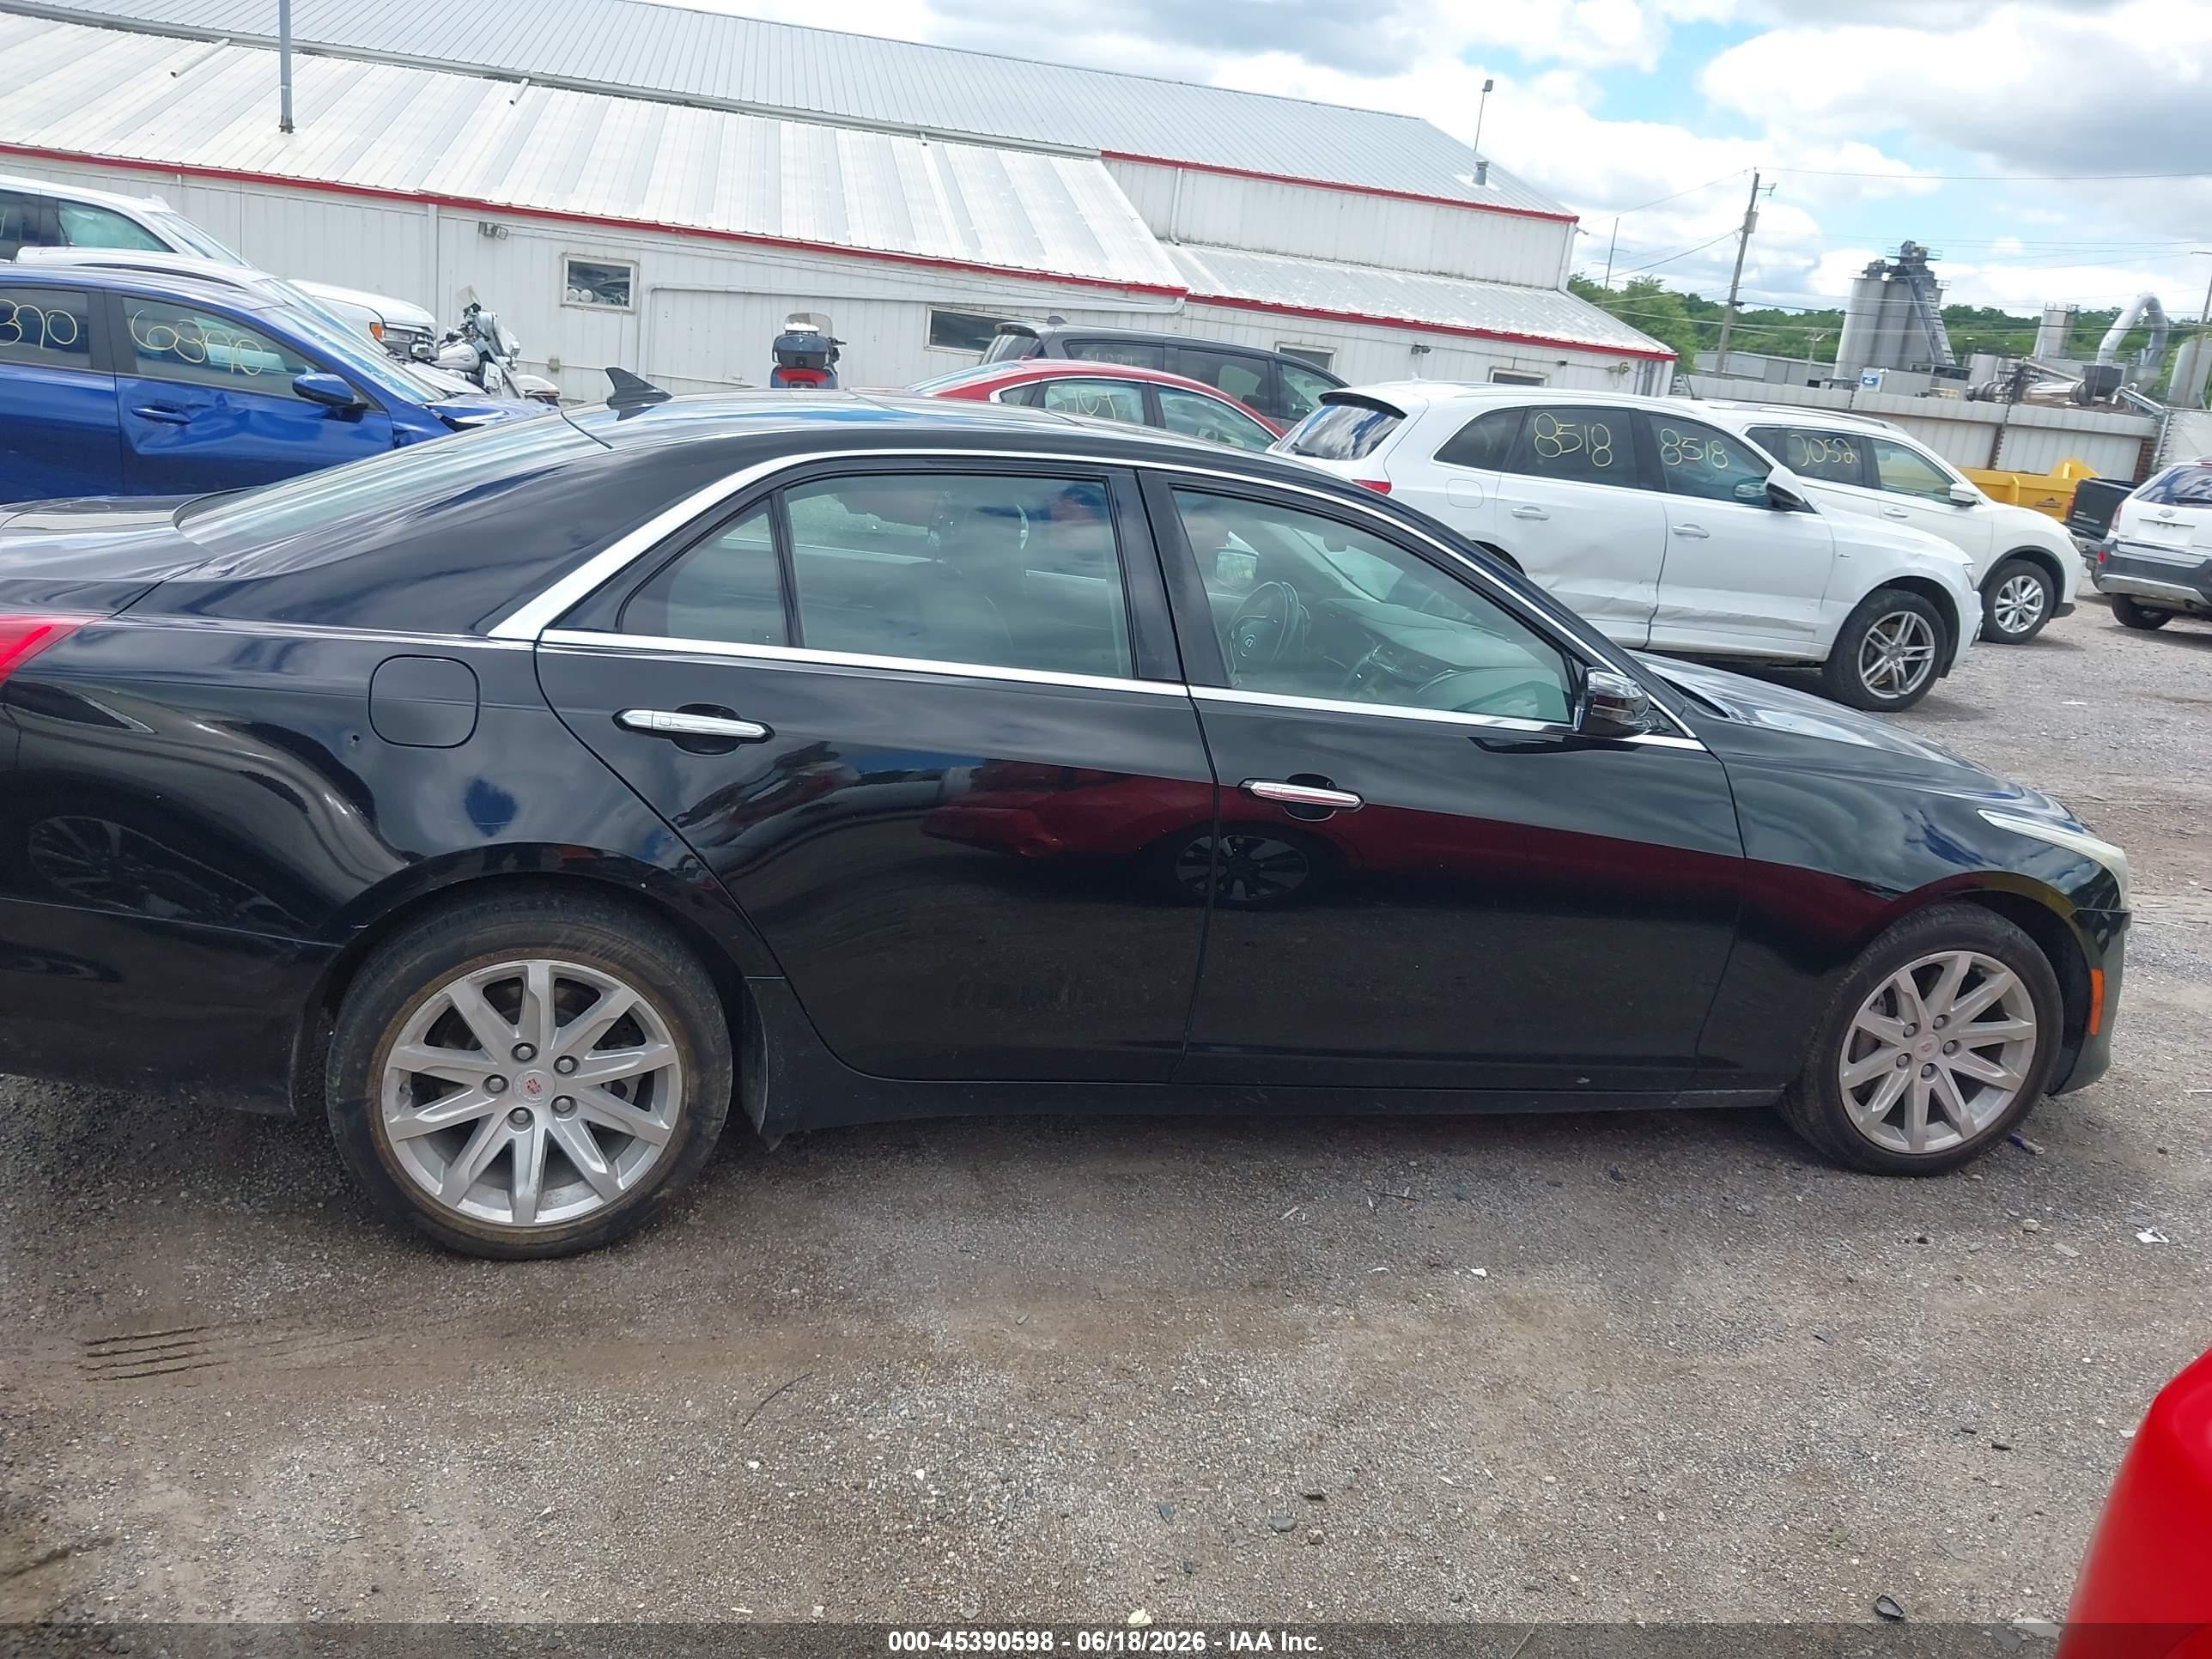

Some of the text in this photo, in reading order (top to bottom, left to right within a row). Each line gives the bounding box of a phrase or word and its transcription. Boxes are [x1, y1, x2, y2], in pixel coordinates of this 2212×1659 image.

[1534, 413, 1612, 467] 8518
[1660, 428, 1729, 468] 8518
[1790, 434, 1860, 466] 3052
